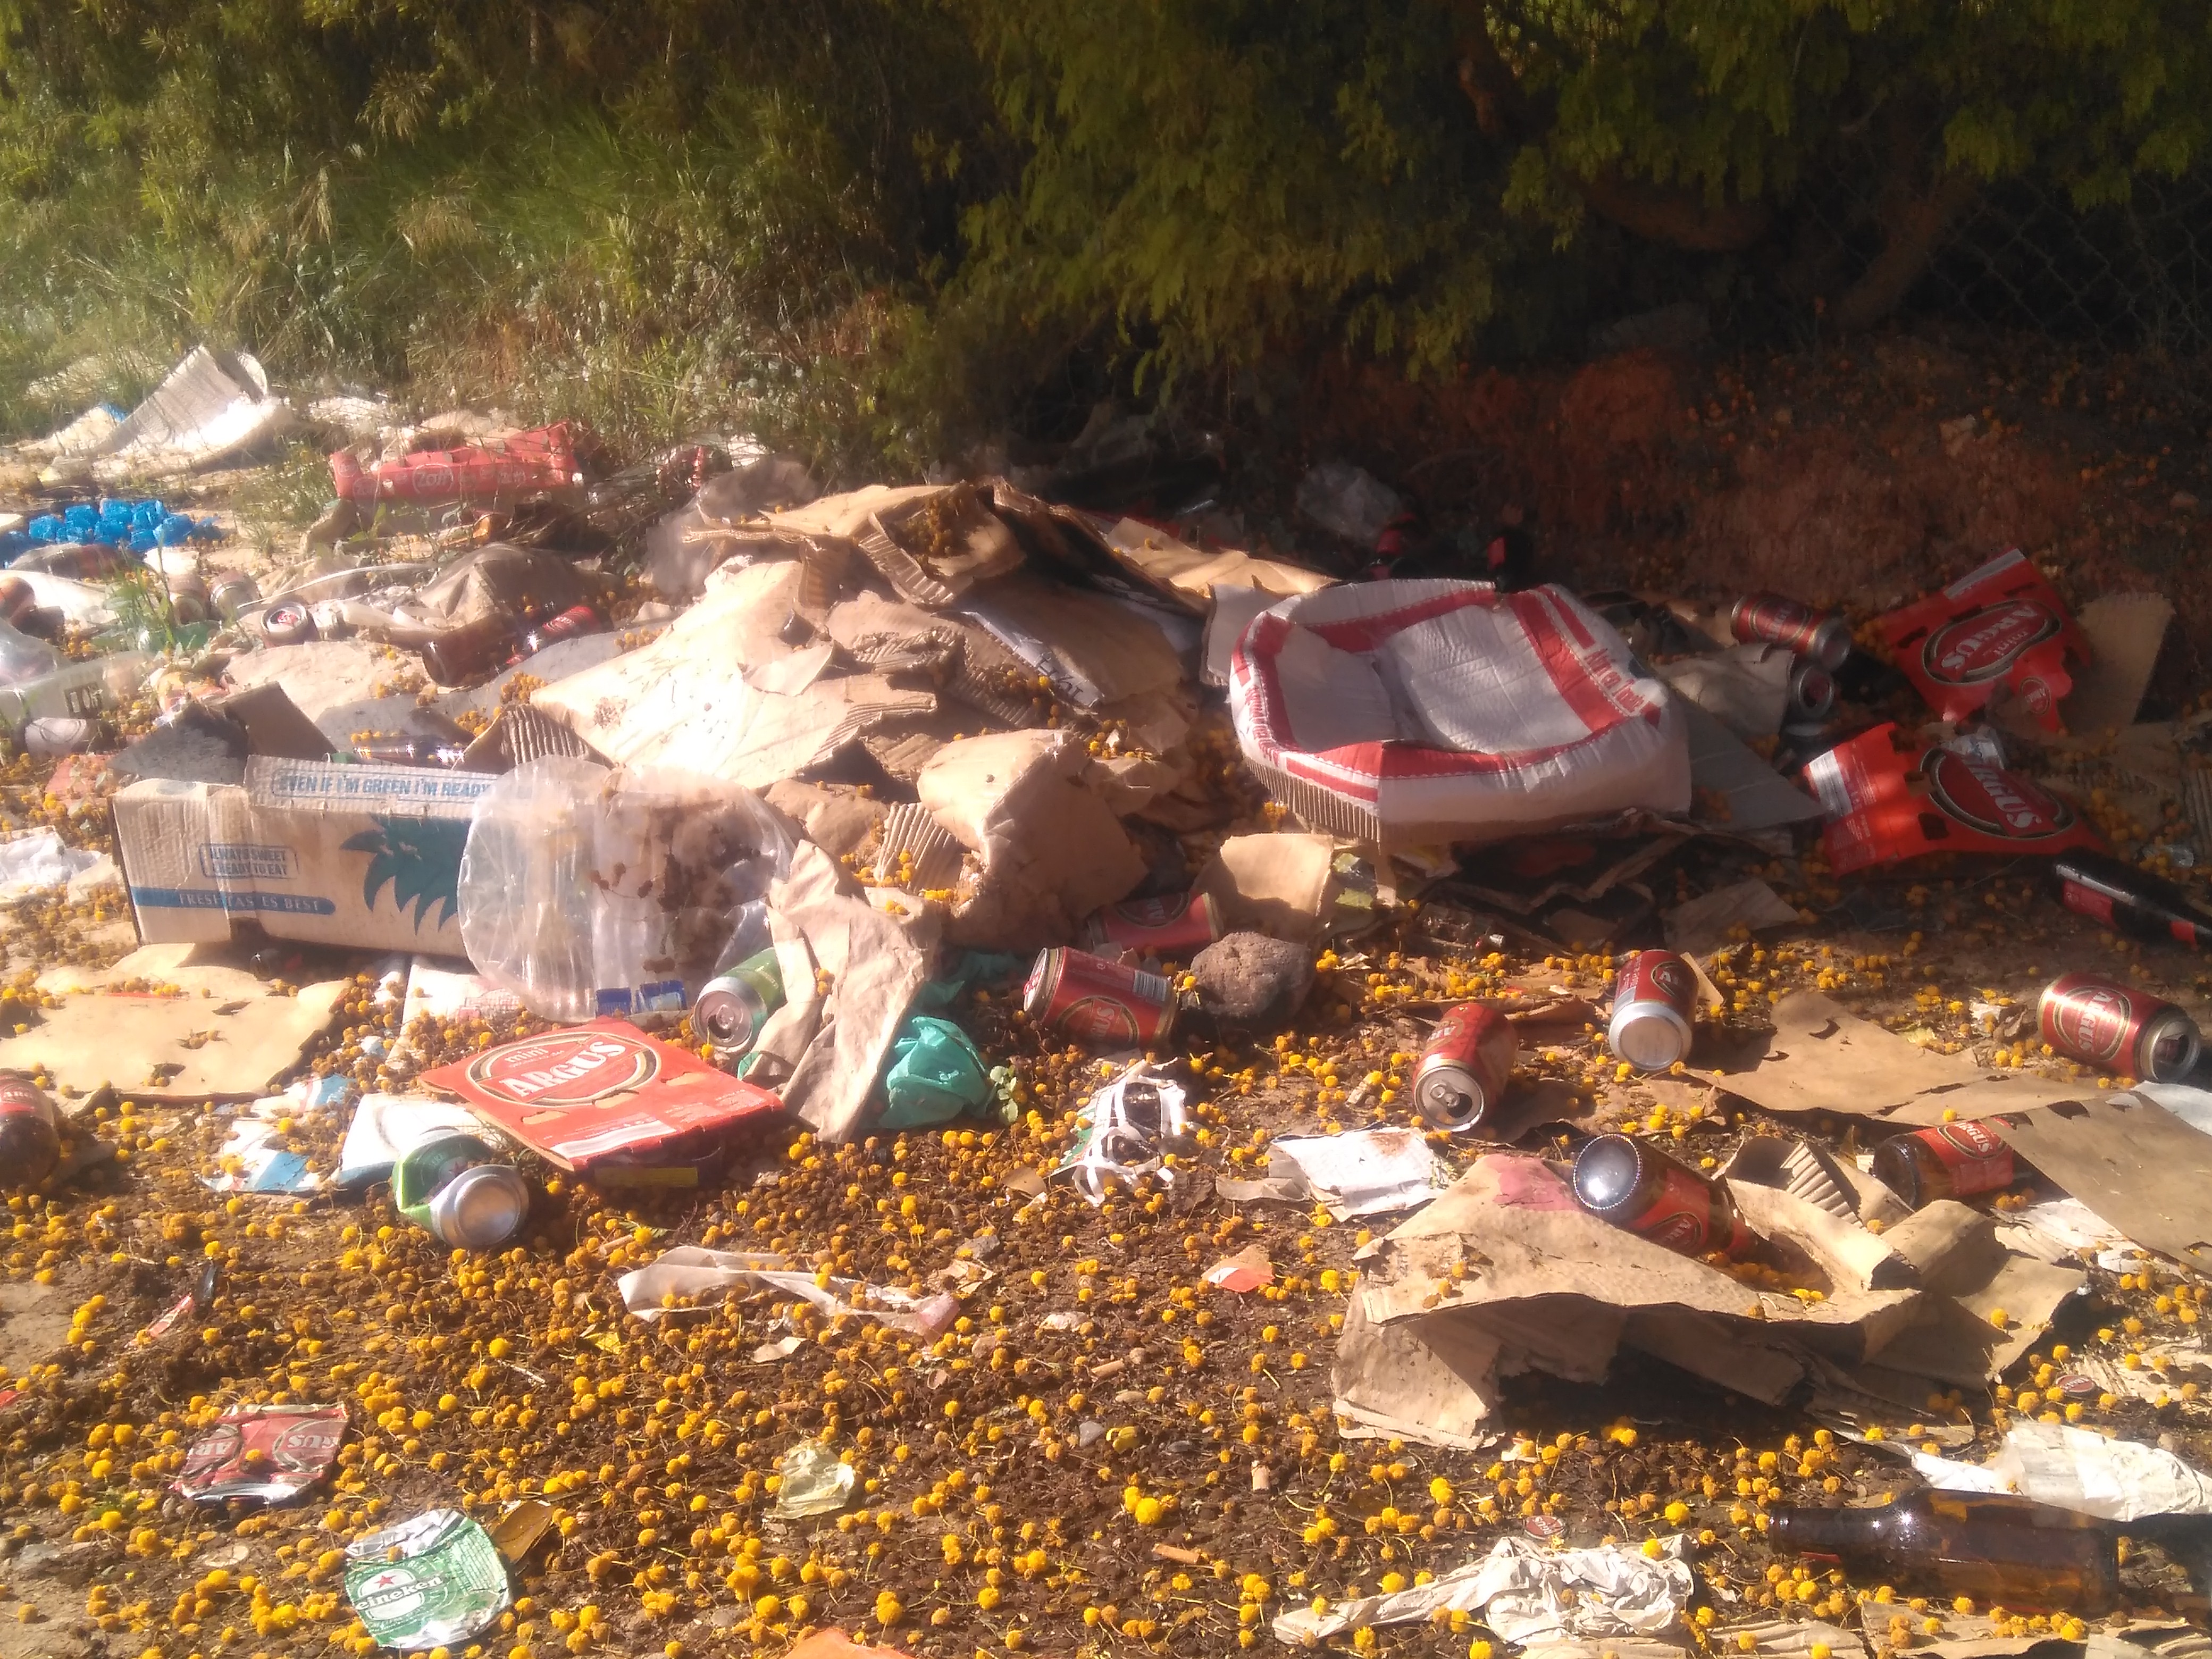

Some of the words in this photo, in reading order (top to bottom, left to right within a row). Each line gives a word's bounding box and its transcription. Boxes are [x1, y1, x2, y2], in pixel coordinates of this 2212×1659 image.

[1940, 605, 2039, 670] ARGUS
[320, 776, 332, 791] IF
[363, 778, 411, 795] GREEN
[2077, 991, 2114, 1052] ARGUS
[498, 1041, 627, 1097] ARGUS
[504, 1046, 550, 1064] mini
[356, 1575, 443, 1611] eineken
